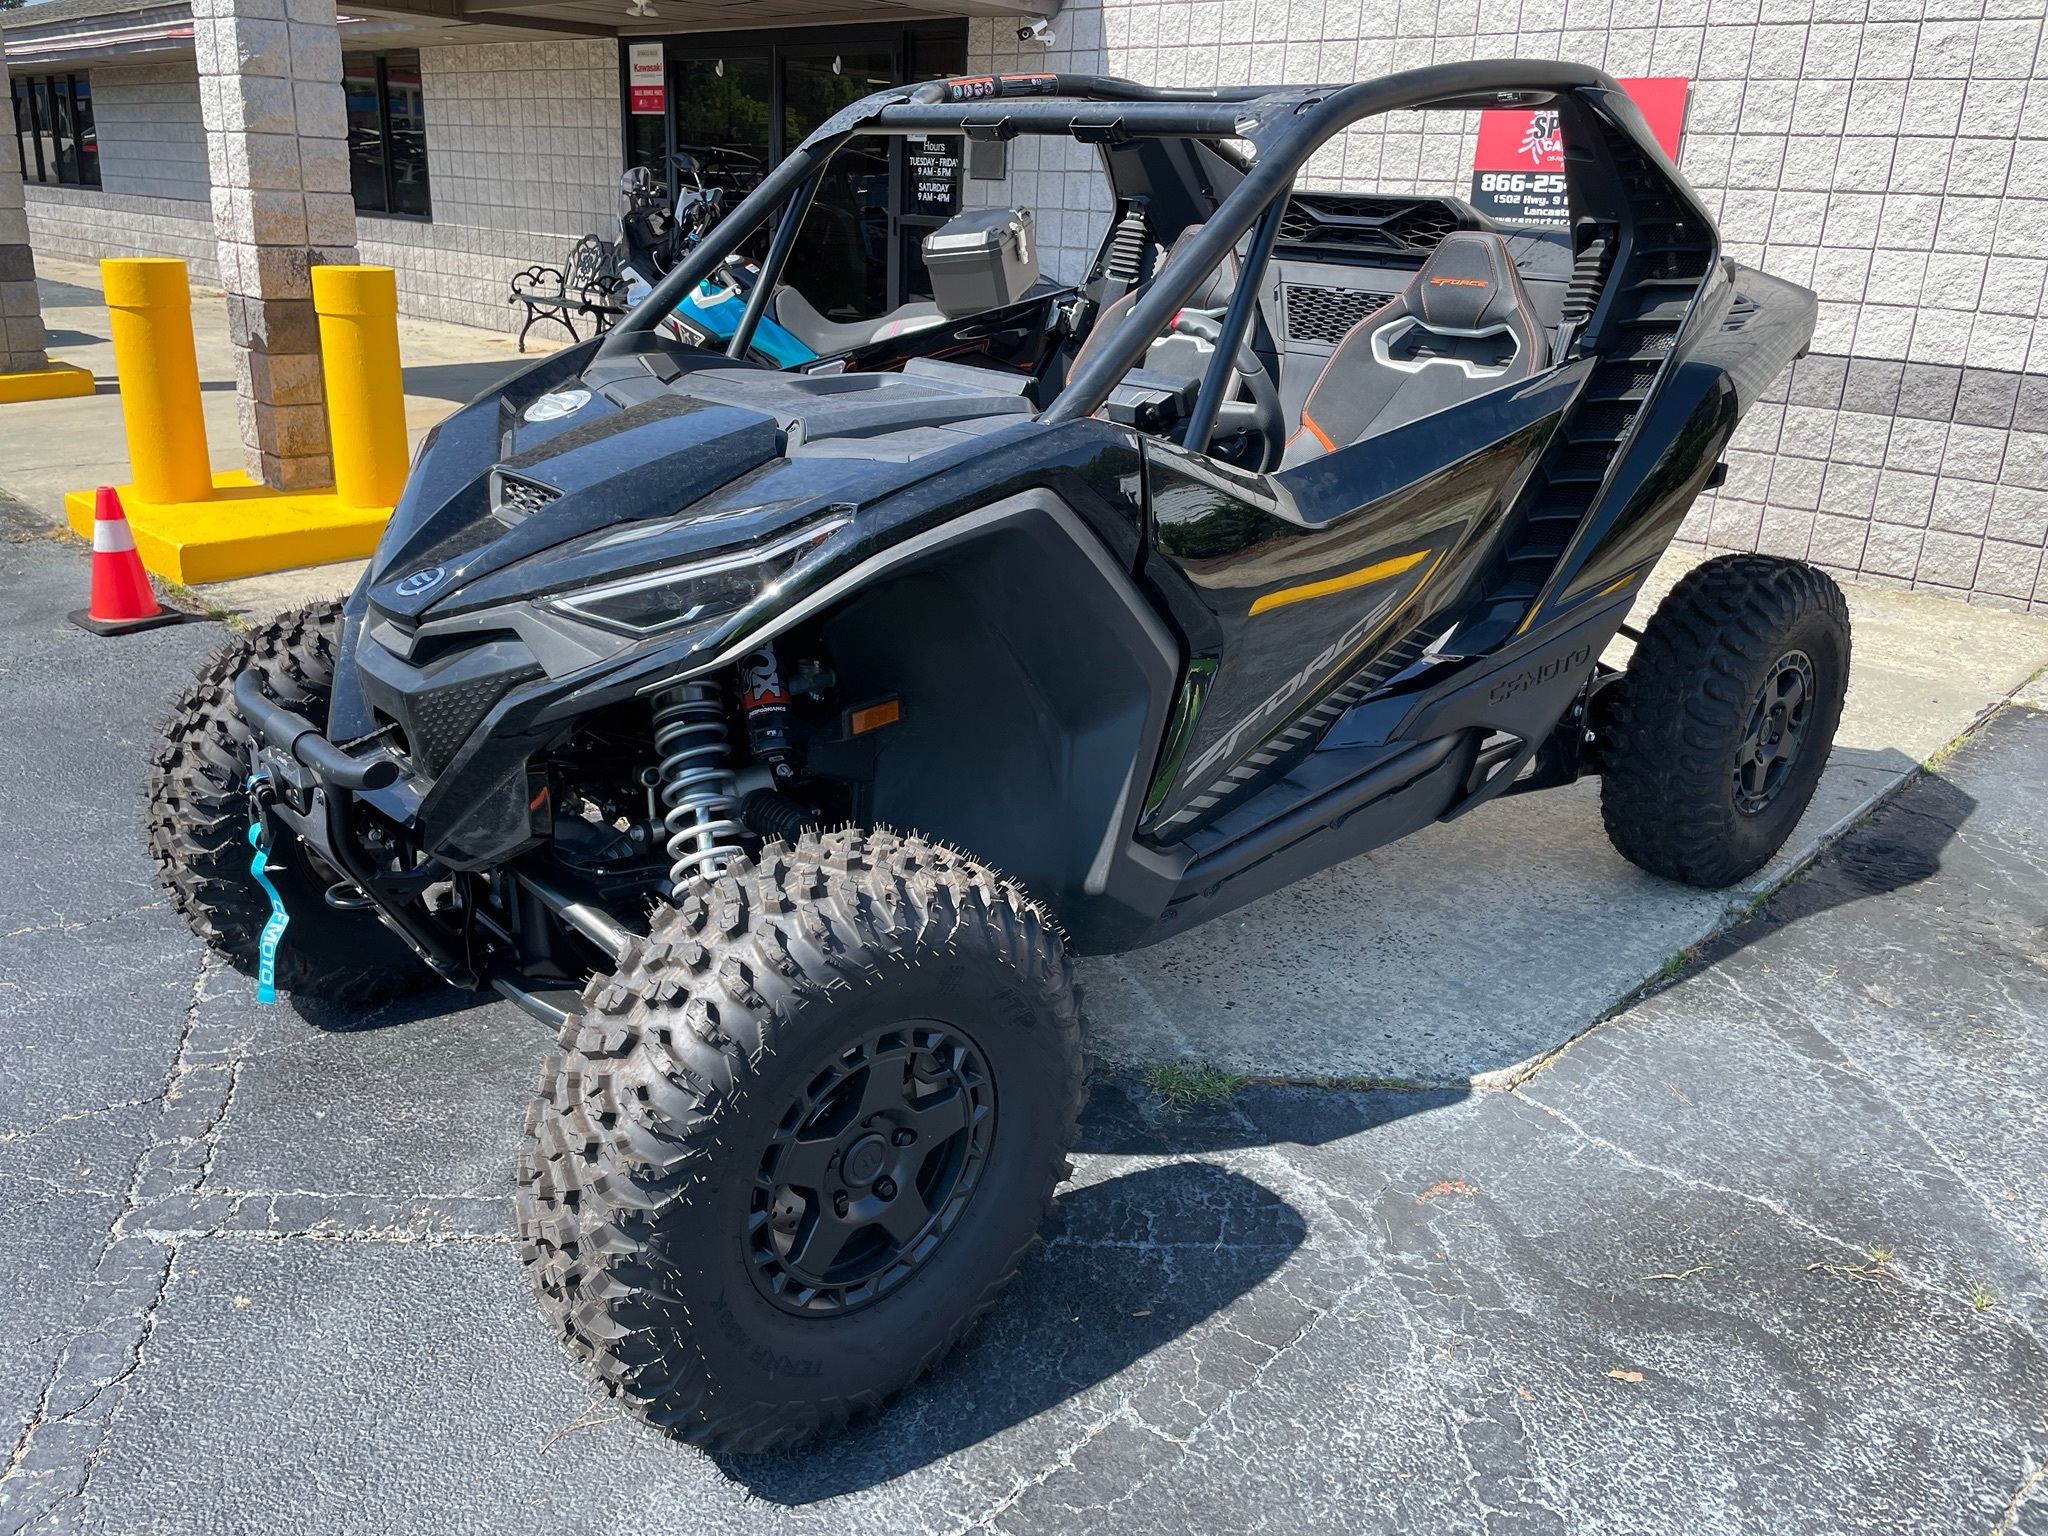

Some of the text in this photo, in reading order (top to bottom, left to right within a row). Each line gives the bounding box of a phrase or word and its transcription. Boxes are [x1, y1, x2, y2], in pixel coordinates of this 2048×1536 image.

[634, 63, 662, 72] Kawasaki
[924, 141, 945, 151] Hours
[910, 157, 935, 166] TUESDAY
[918, 167, 922, 176] 9
[922, 167, 933, 176] AM
[937, 168, 941, 176] 6
[942, 168, 951, 176] PM
[918, 182, 949, 192] SATURDAY
[1481, 174, 1567, 193] 866-25
[918, 192, 922, 200] 9
[922, 192, 933, 201] AM
[1494, 195, 1521, 204] 1502
[1523, 195, 1549, 207] Hwy.
[1552, 195, 1561, 205] 9
[1487, 644, 1591, 706] CFMOTO
[261, 899, 287, 986] CFMOTO
